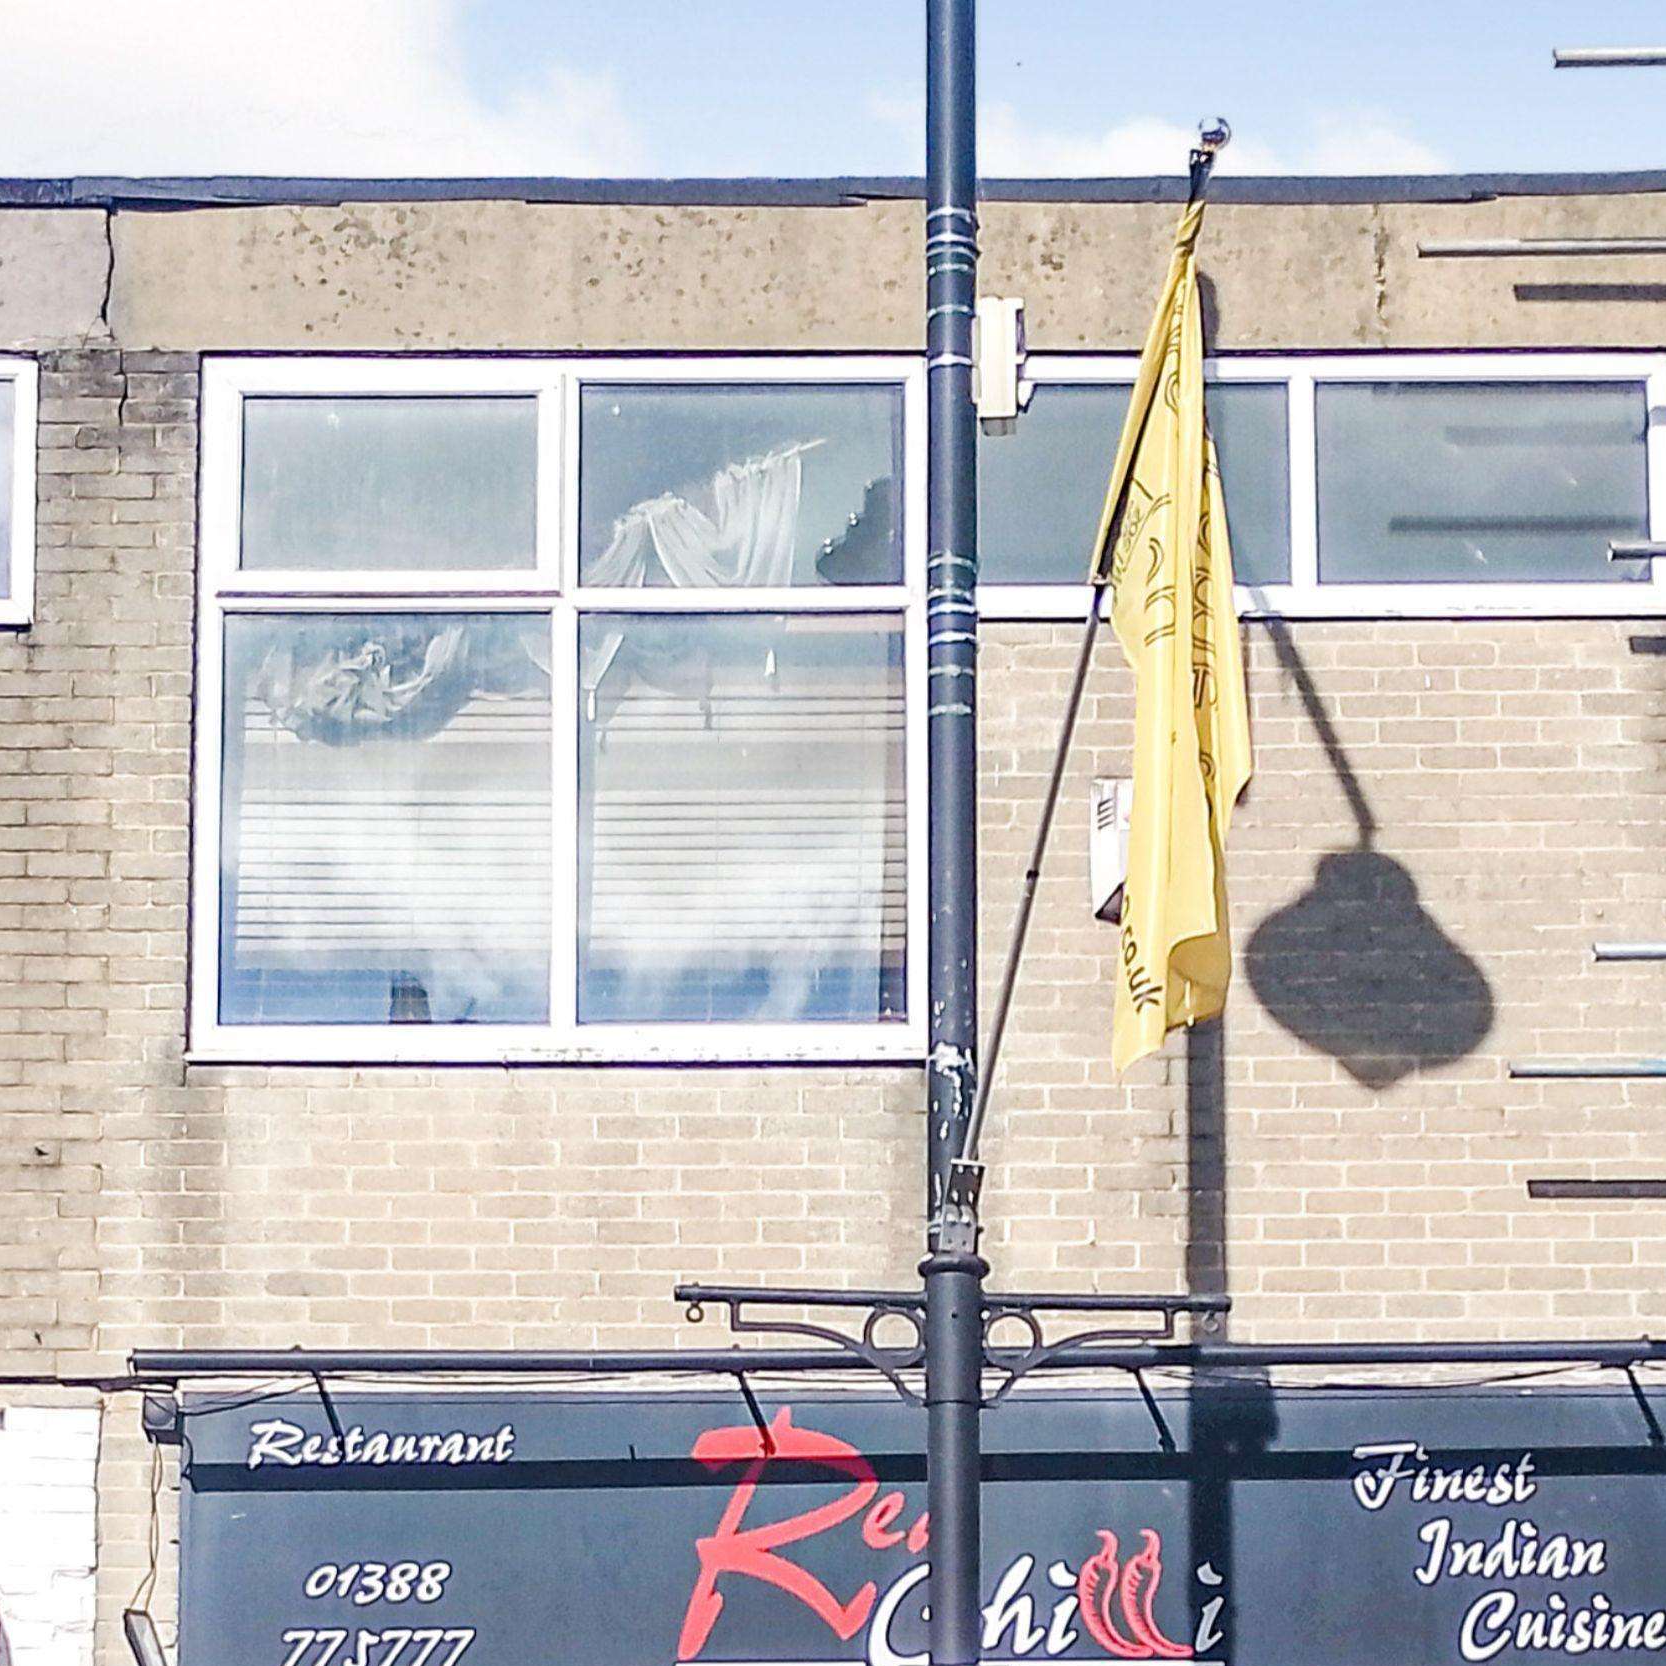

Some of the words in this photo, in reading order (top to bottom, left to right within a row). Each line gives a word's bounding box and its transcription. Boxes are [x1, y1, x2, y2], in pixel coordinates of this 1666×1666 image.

[248, 1418, 515, 1469] Restaurant
[1352, 1440, 1537, 1511] Finest
[1414, 1516, 1607, 1585] Indian
[304, 1561, 452, 1604] 01388
